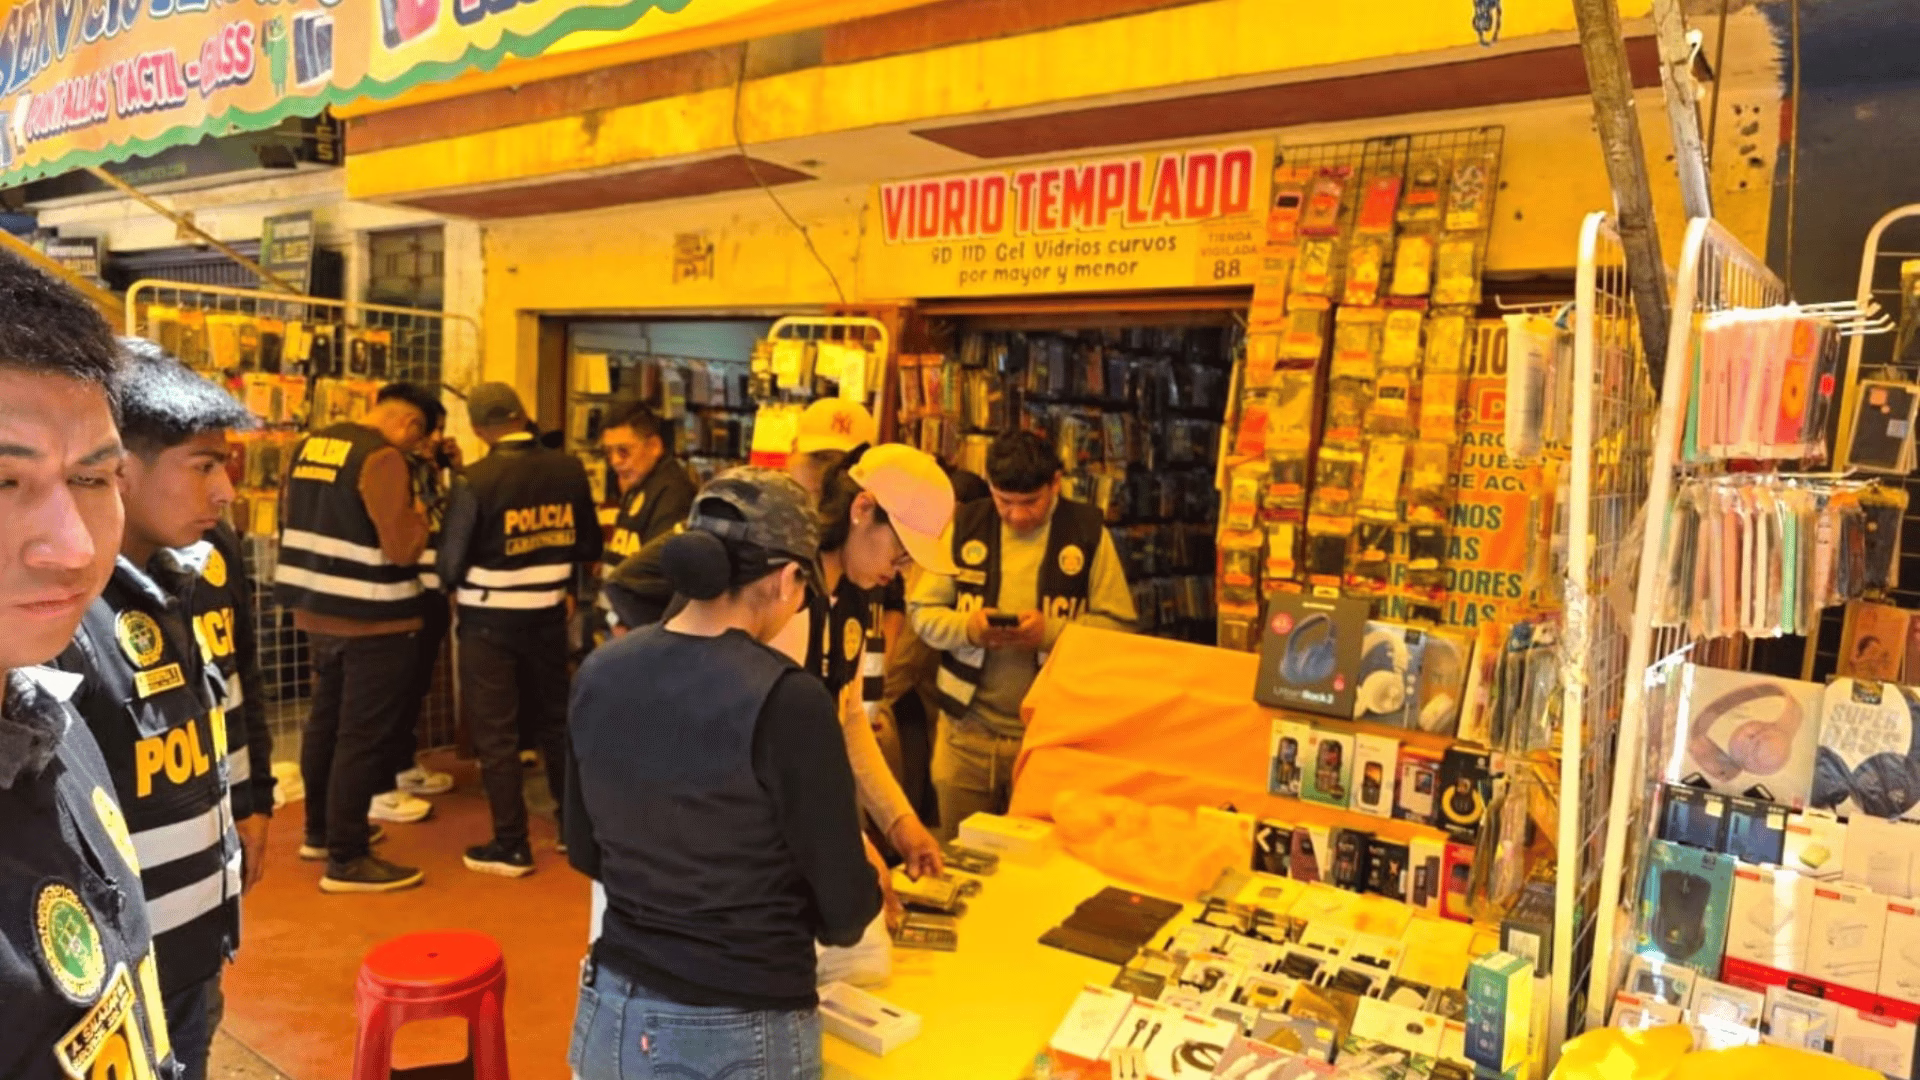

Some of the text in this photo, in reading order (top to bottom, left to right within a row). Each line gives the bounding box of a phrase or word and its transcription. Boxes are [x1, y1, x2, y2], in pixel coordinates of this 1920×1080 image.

[882, 148, 1254, 242] VIDRIO TEMPLADO
[995, 241, 1026, 262] Gel
[1034, 237, 1101, 259] Vidrios
[1108, 235, 1177, 254] curvos
[959, 259, 1139, 287] por mayor y menor
[1213, 258, 1241, 280] 88
[504, 502, 575, 536] POLICIA
